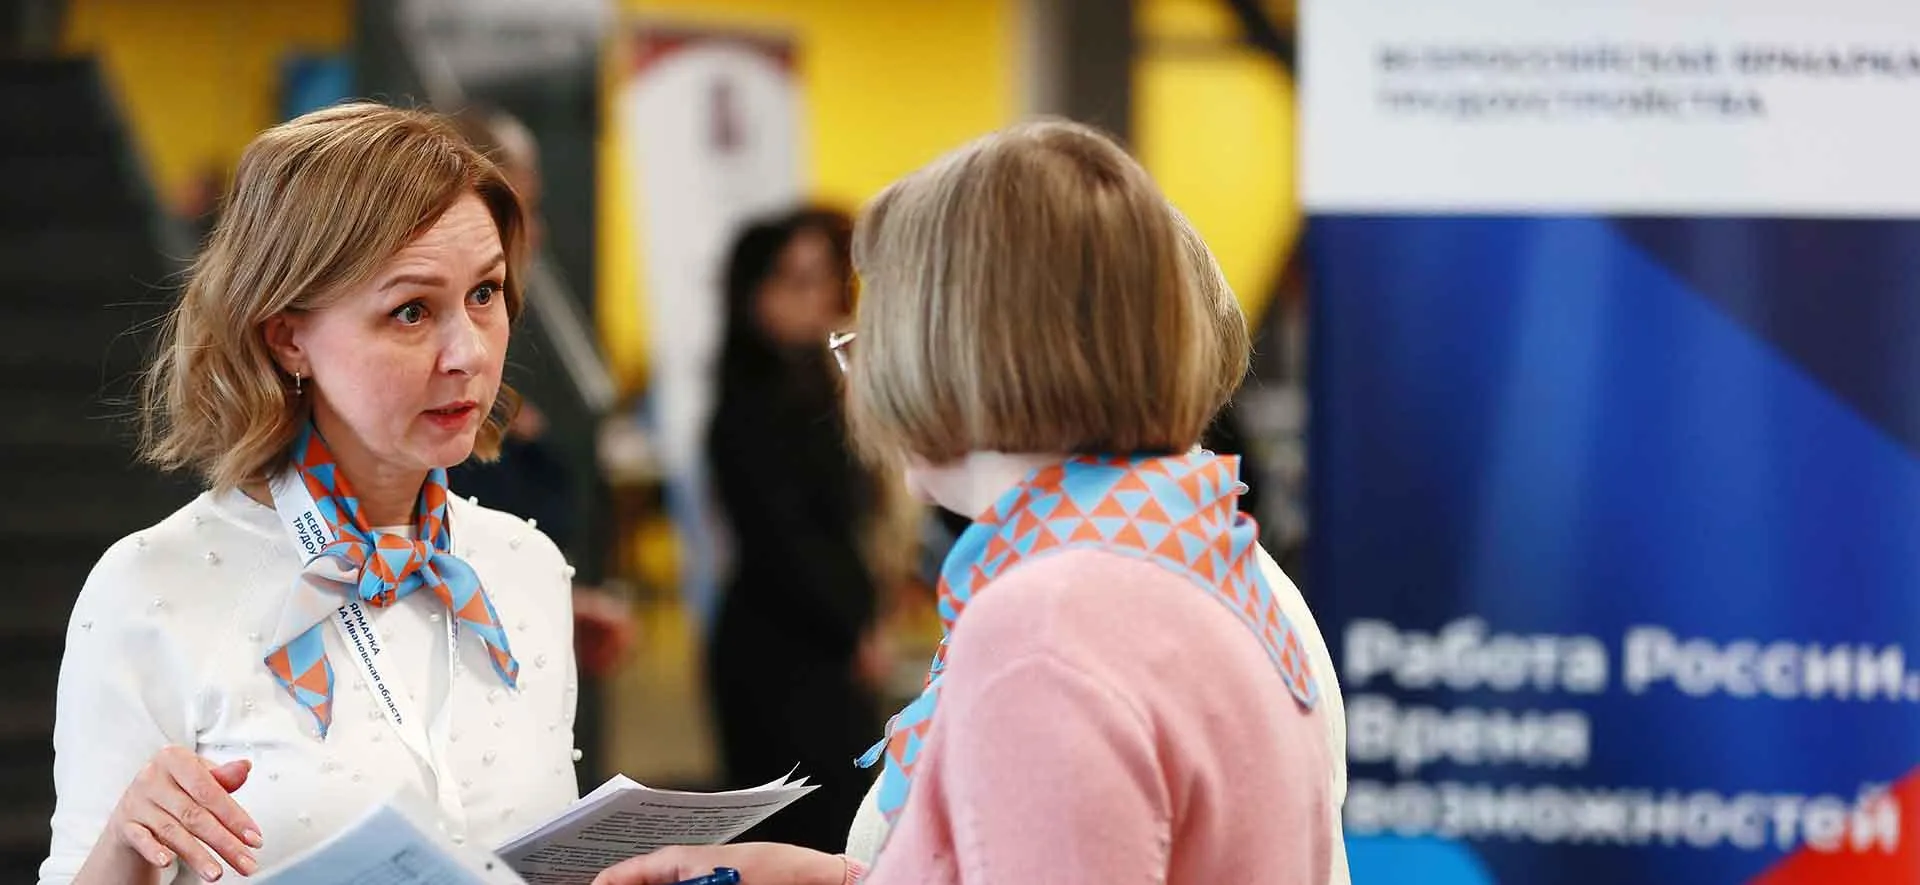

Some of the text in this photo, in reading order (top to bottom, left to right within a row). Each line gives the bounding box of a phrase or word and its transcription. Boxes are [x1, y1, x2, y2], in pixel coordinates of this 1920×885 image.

[349, 602, 381, 656] ЯРМАРКА
[1345, 617, 1608, 693] Работа
[344, 619, 381, 682] Ивановская
[377, 682, 403, 726] область
[1347, 697, 1590, 774] Время
[1347, 782, 1900, 853] возможностей
